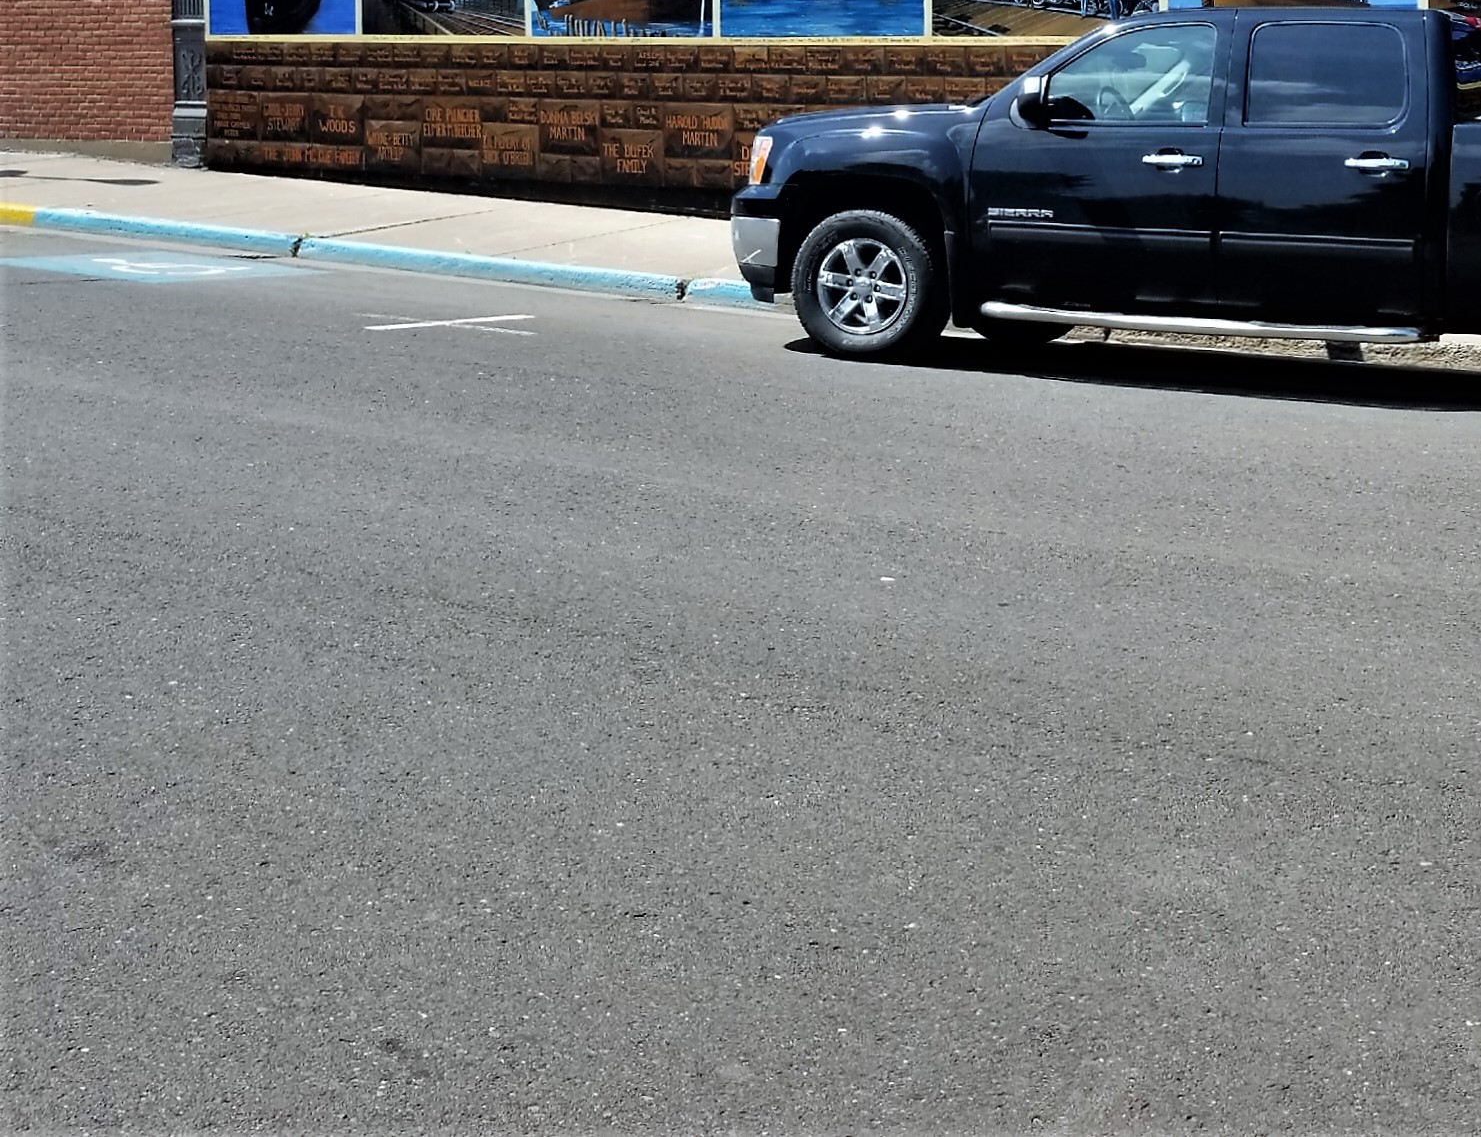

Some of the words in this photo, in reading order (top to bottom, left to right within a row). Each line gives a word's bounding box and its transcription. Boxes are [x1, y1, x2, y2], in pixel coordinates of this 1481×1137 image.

[319, 119, 356, 133] WOODS
[665, 115, 697, 129] HAROLD
[550, 126, 585, 141] MARTIN
[682, 132, 718, 147] MARTIN
[603, 143, 619, 158] THE
[617, 159, 647, 174] FAMILY
[987, 207, 1054, 218] SIERRA
